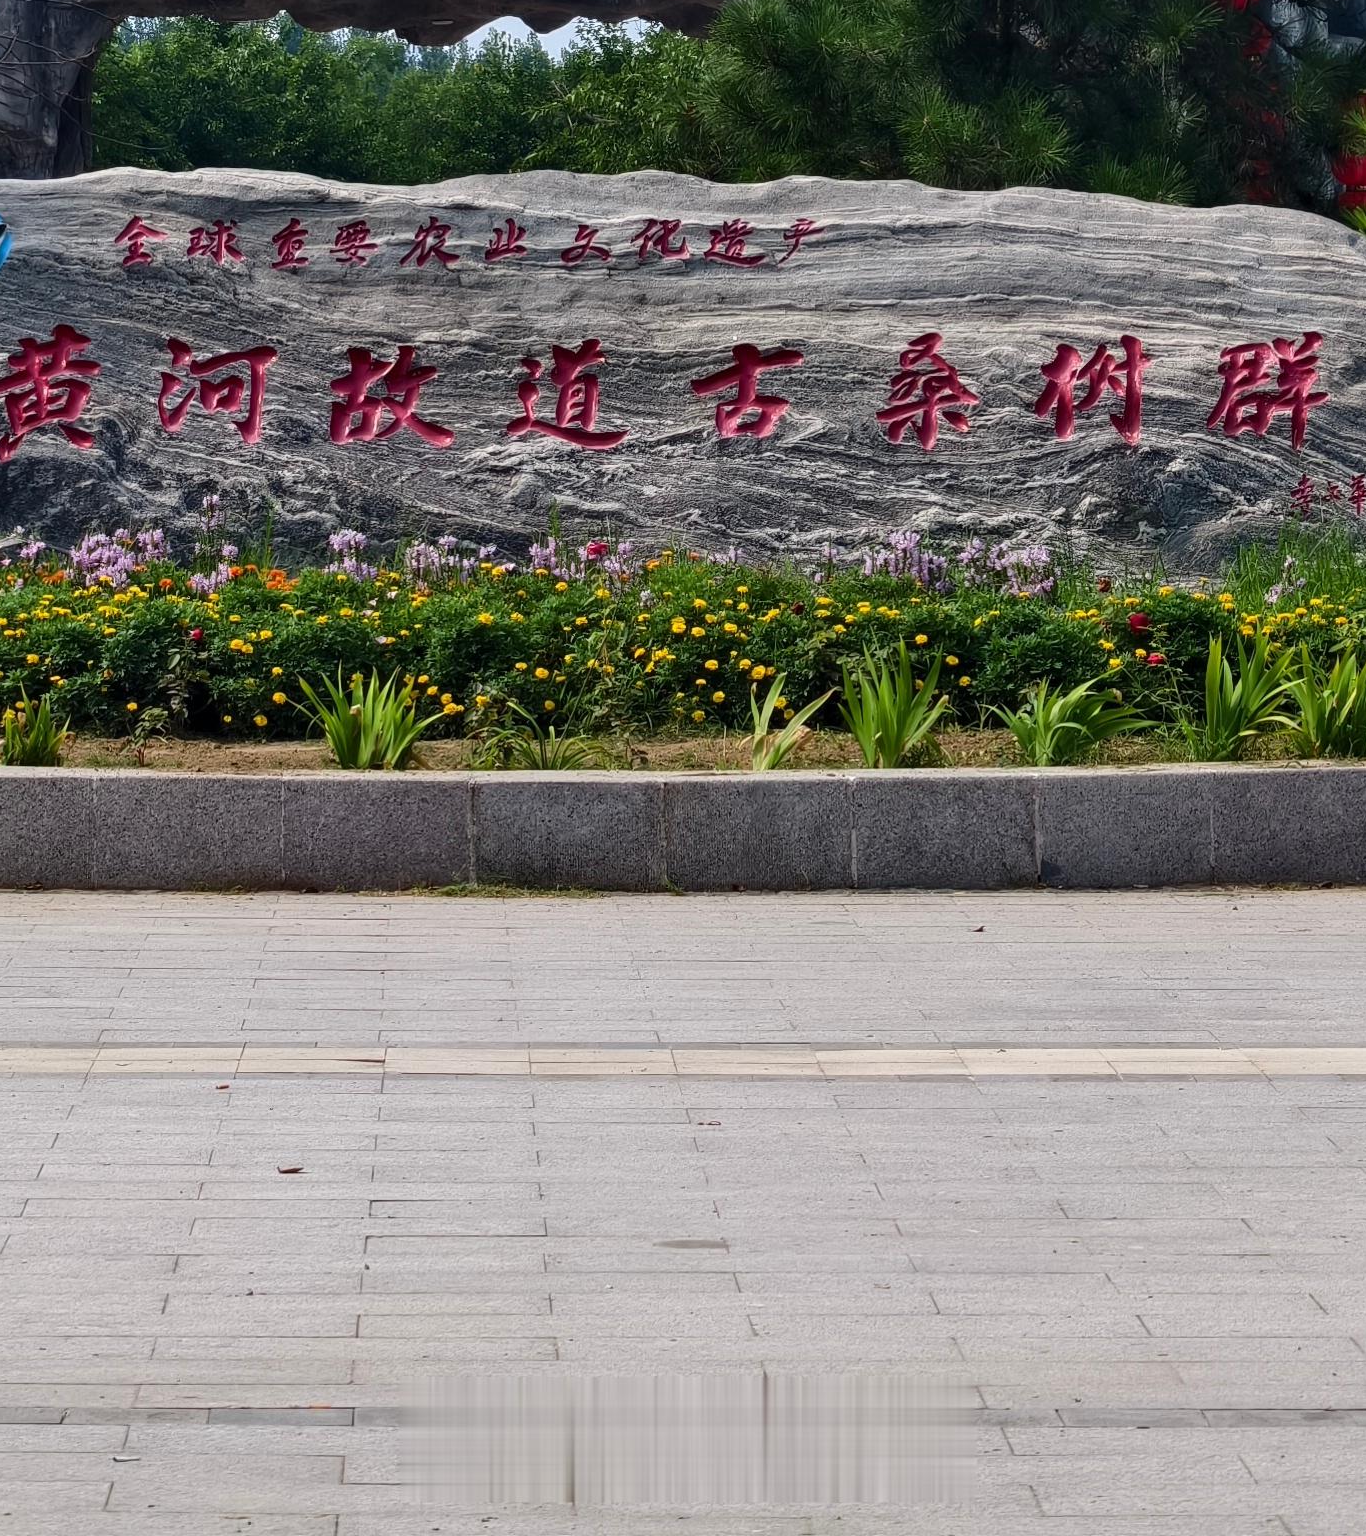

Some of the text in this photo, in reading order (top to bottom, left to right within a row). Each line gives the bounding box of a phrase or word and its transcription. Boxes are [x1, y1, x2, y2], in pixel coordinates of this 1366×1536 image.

[113, 215, 825, 270] 全球重要农业文化遗产
